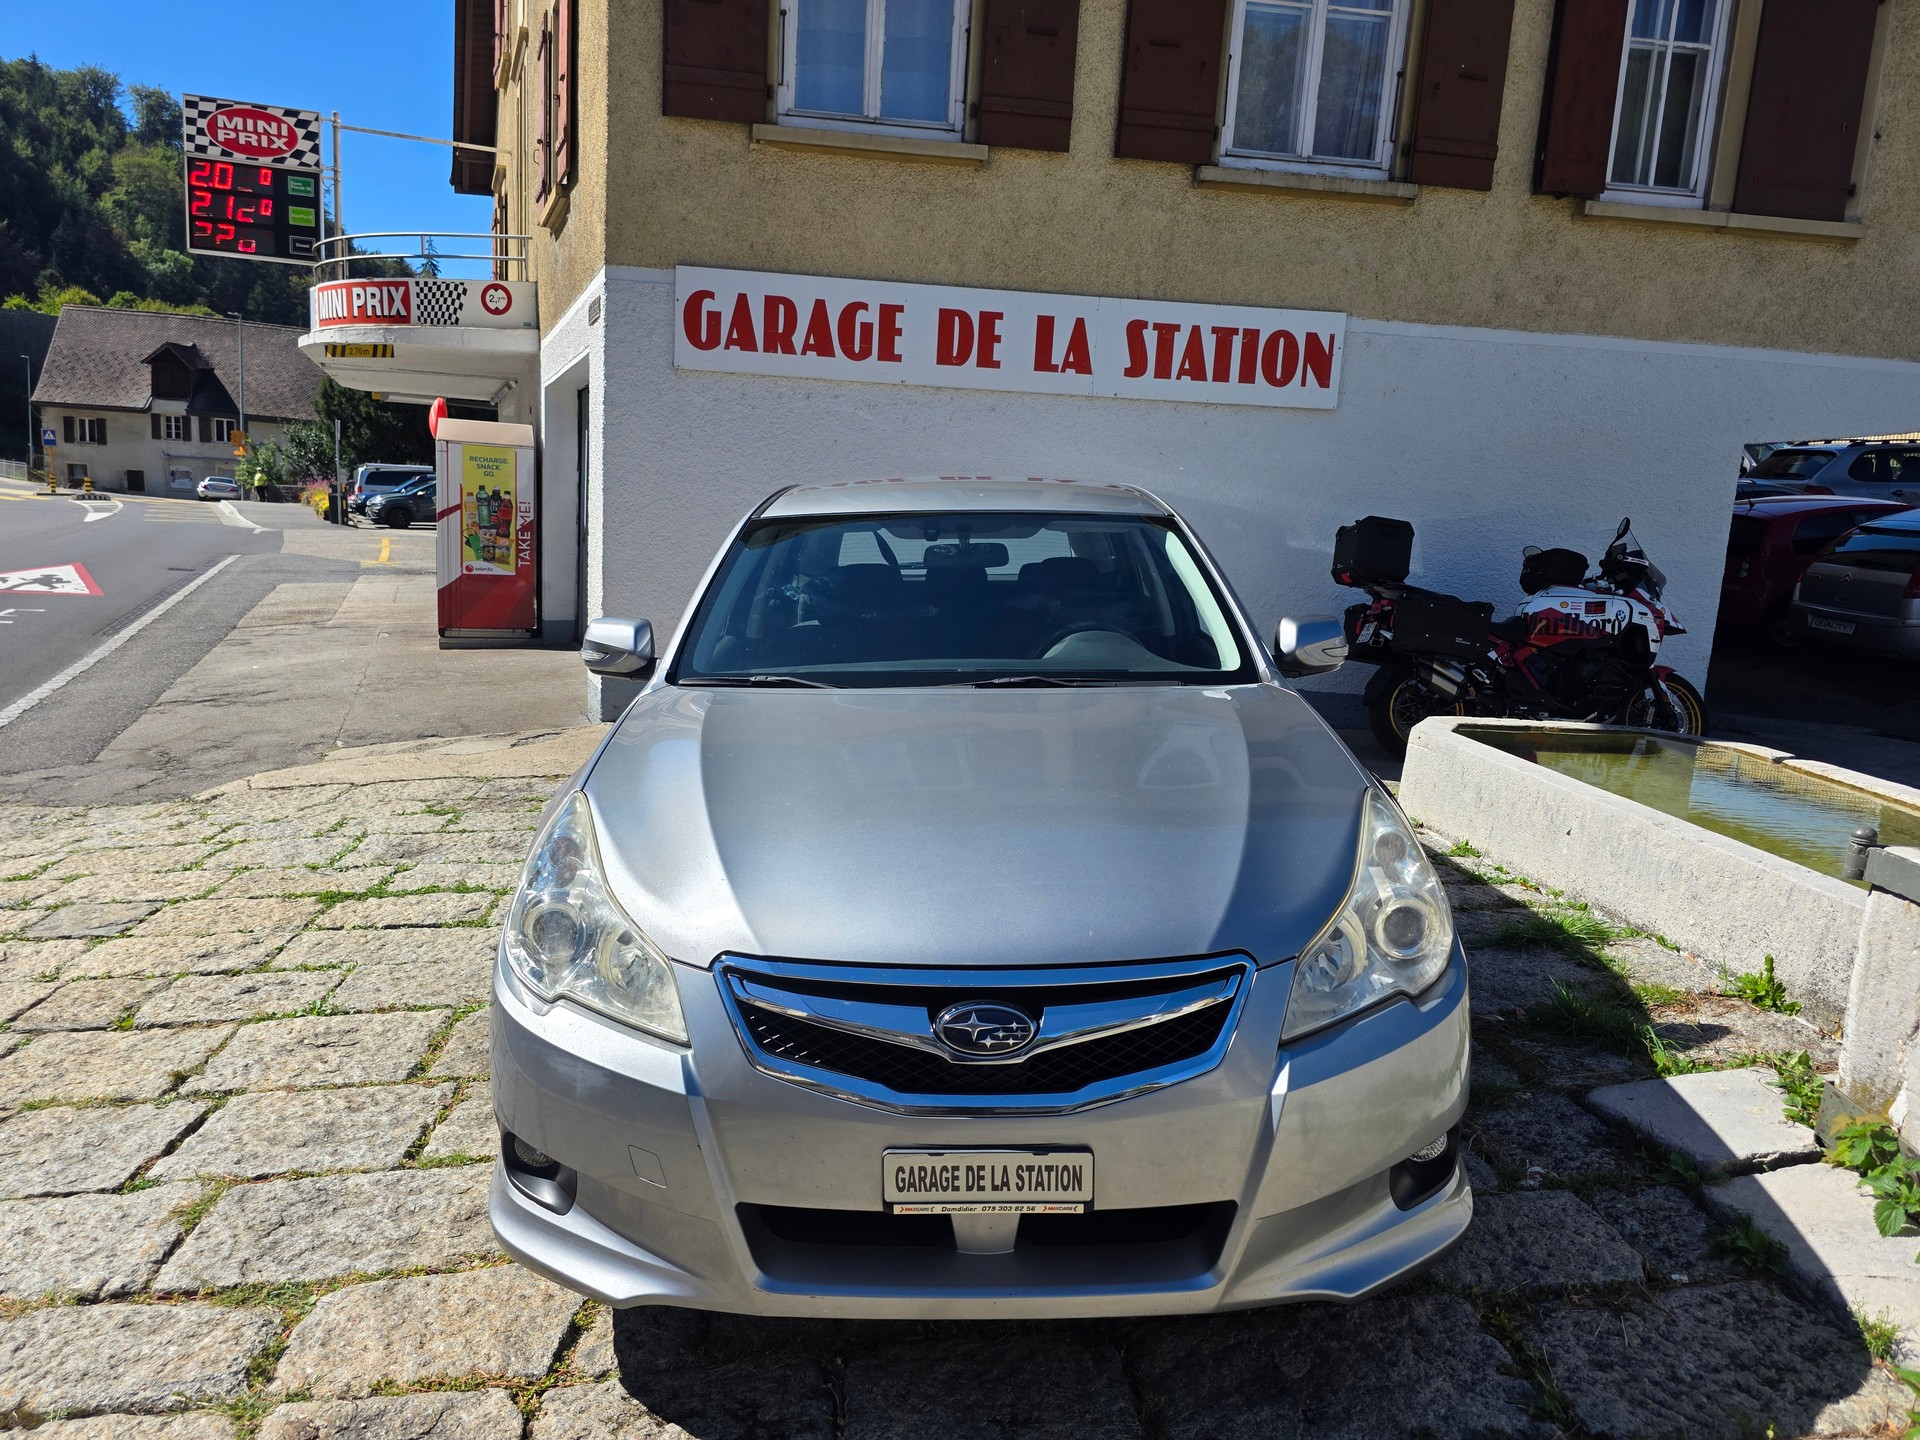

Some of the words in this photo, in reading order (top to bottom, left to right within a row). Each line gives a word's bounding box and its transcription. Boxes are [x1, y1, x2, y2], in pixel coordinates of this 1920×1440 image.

[216, 114, 289, 136] MINI
[216, 129, 290, 151] PRIX
[318, 288, 348, 321] MINI
[352, 286, 408, 318] PRIX
[683, 289, 905, 363] GARAGE
[936, 307, 1004, 369] DE
[1033, 314, 1093, 375] LA
[1123, 319, 1335, 389] STATION
[469, 456, 509, 465] RECHARGE.
[476, 463, 503, 471] SNACK.
[518, 531, 531, 567] TAKE
[895, 1165, 960, 1192] GARAGE
[965, 1165, 986, 1192] DE
[990, 1165, 1011, 1192] LA
[1015, 1164, 1083, 1192] STATION
